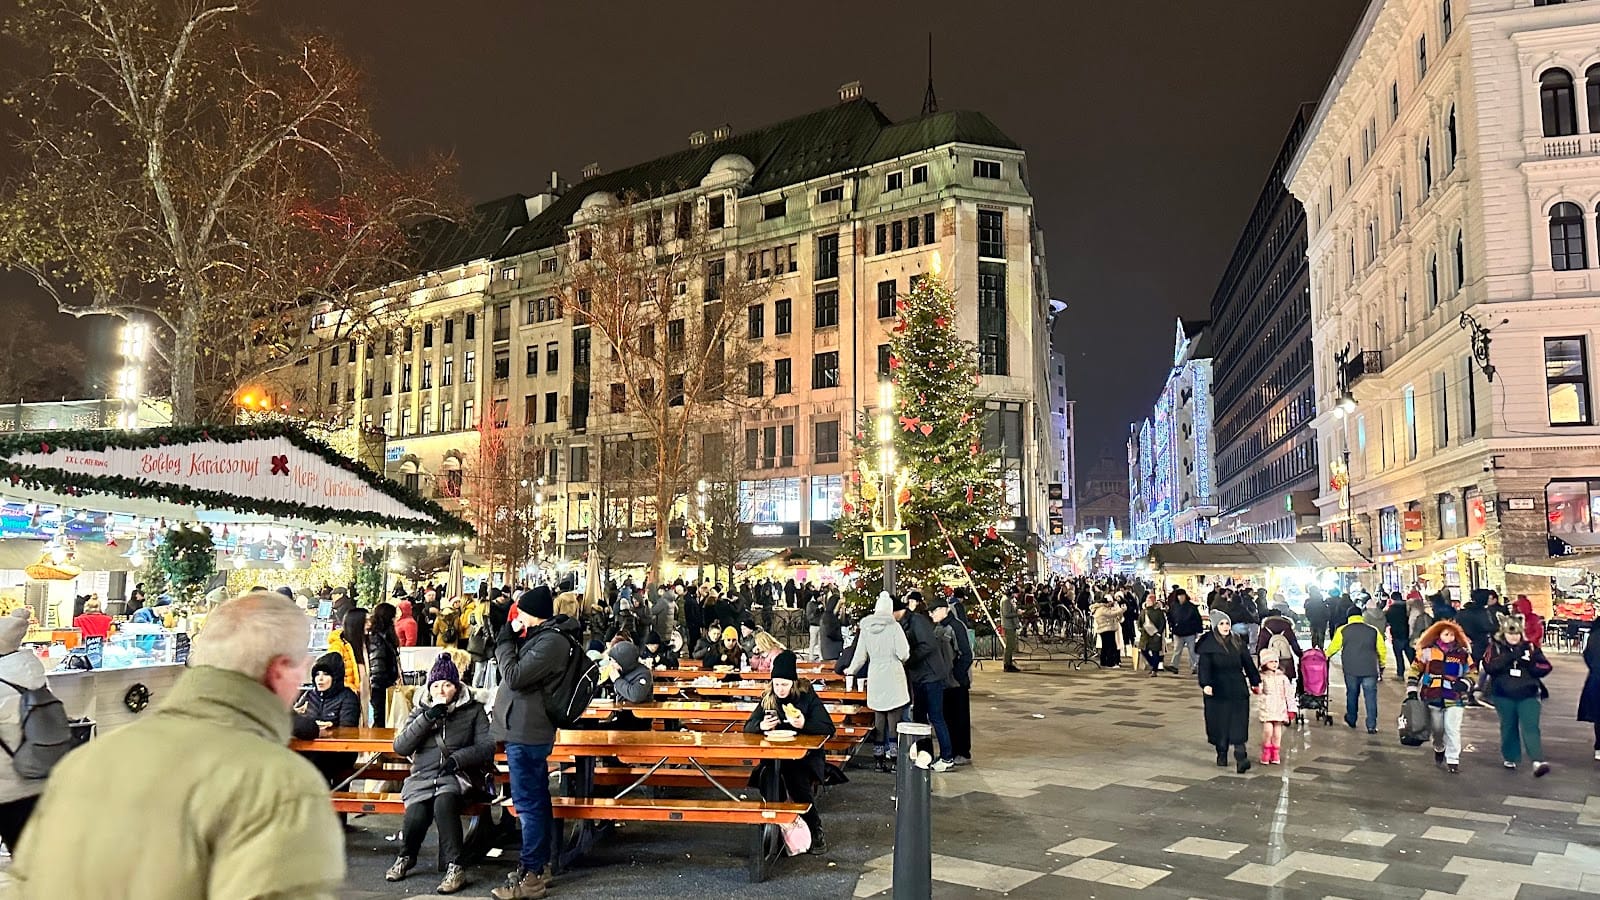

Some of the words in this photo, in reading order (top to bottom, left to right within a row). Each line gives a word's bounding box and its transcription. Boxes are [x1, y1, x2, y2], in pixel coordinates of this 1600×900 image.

[65, 455, 78, 464] XXL
[80, 457, 108, 468] CATERING
[139, 452, 181, 475] Boldog
[292, 465, 319, 492] Merry
